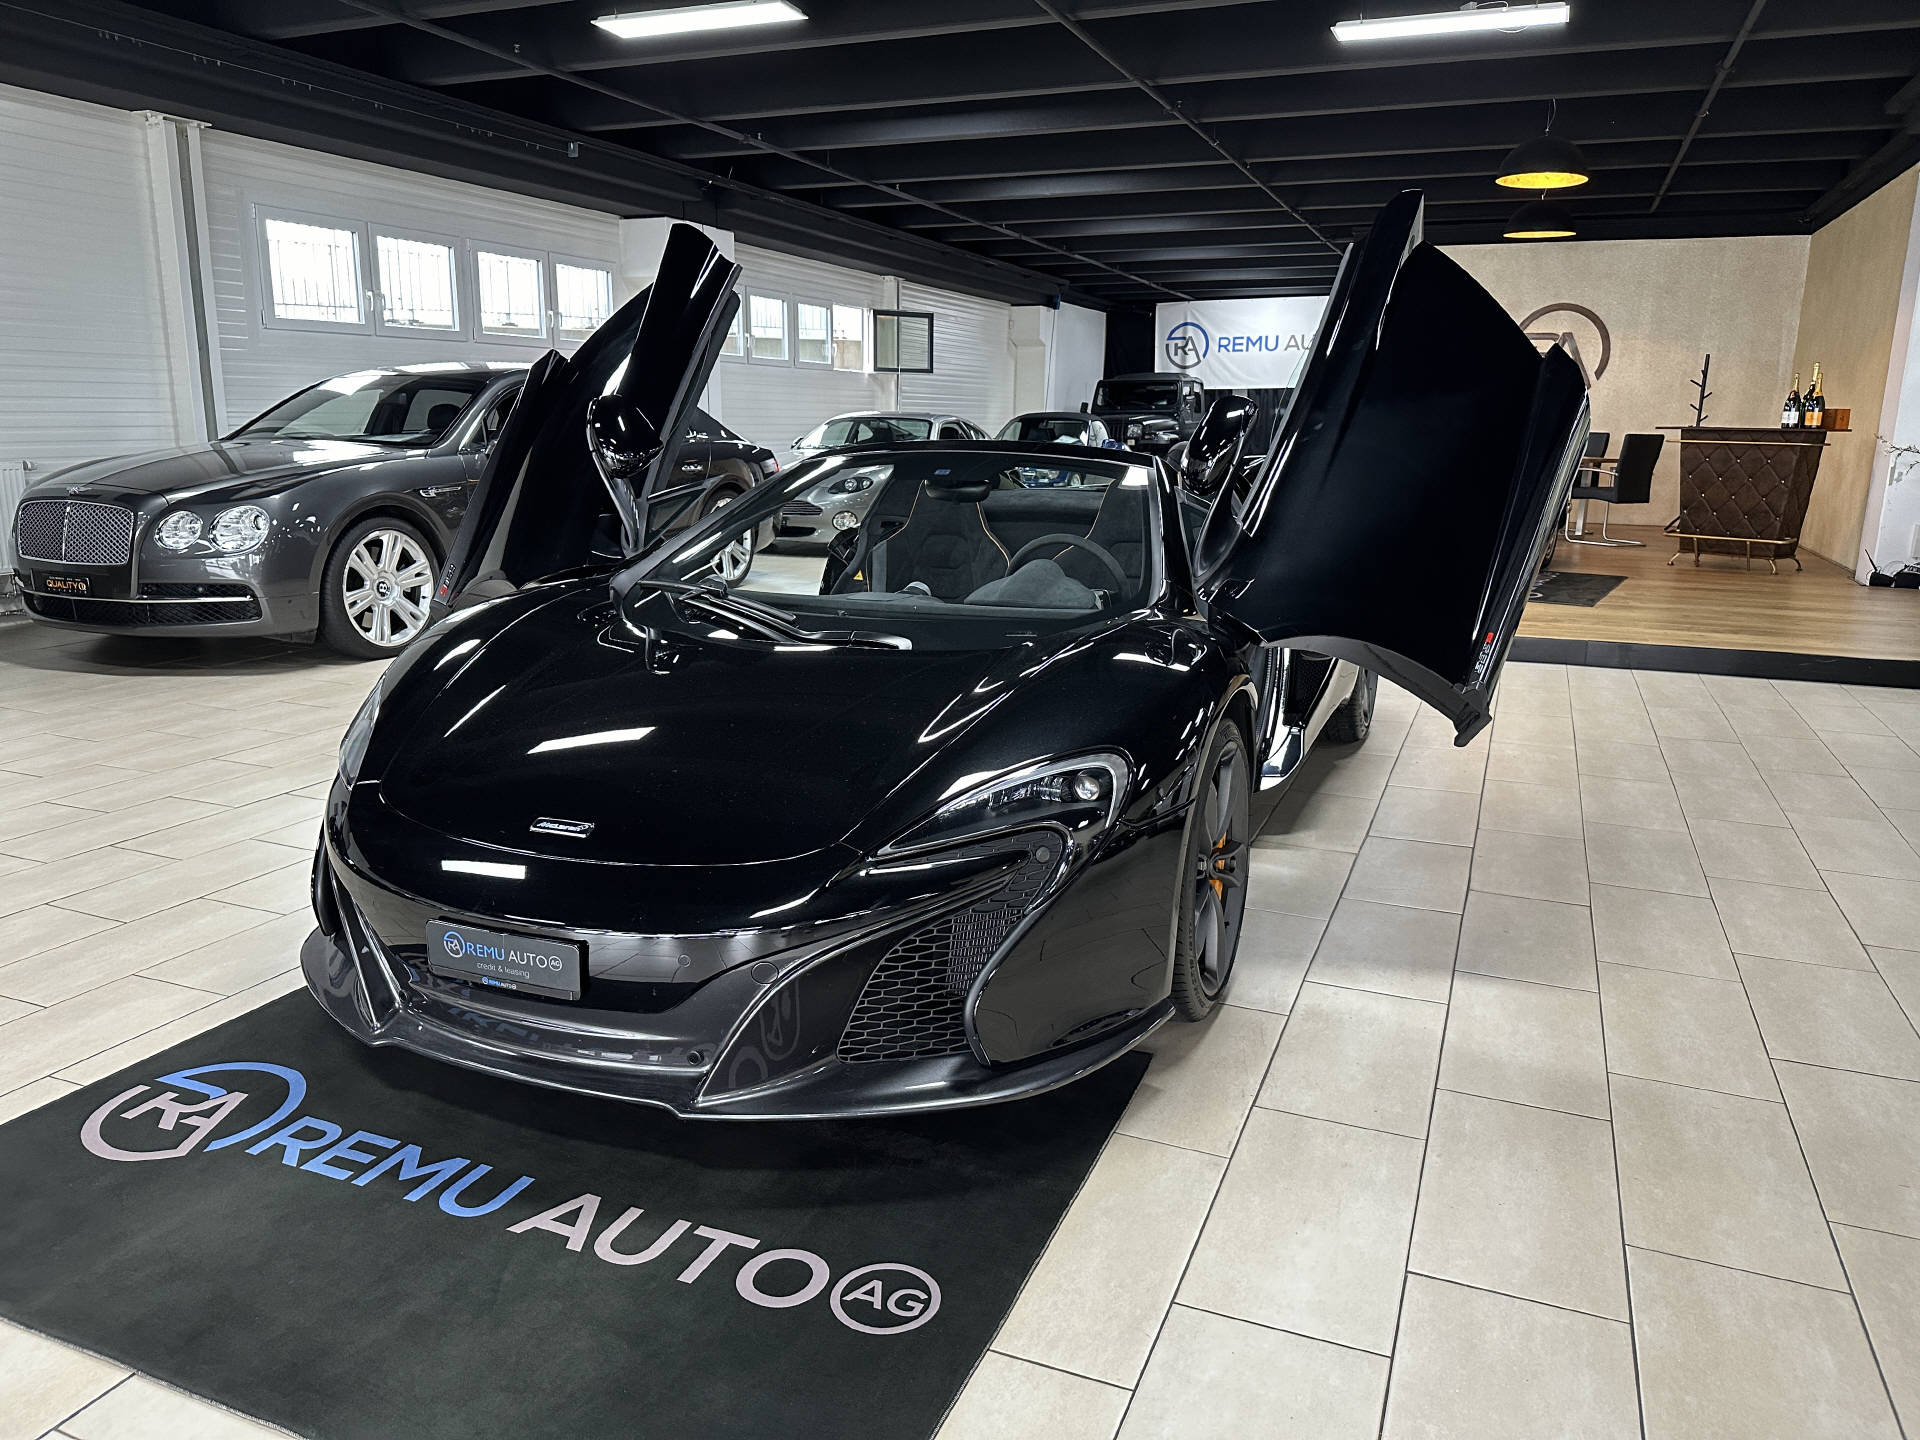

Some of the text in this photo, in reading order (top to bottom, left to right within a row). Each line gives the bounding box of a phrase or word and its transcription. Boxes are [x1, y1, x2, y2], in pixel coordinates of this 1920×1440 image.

[1218, 335, 1279, 353] REMU
[1284, 334, 1310, 351] AU
[466, 942, 505, 961] REMU
[508, 950, 548, 968] AUTO
[476, 962, 530, 979] credit & leasing
[245, 1116, 535, 1218] REMU
[505, 1193, 830, 1308] AUTO
[842, 1279, 929, 1318] AG
